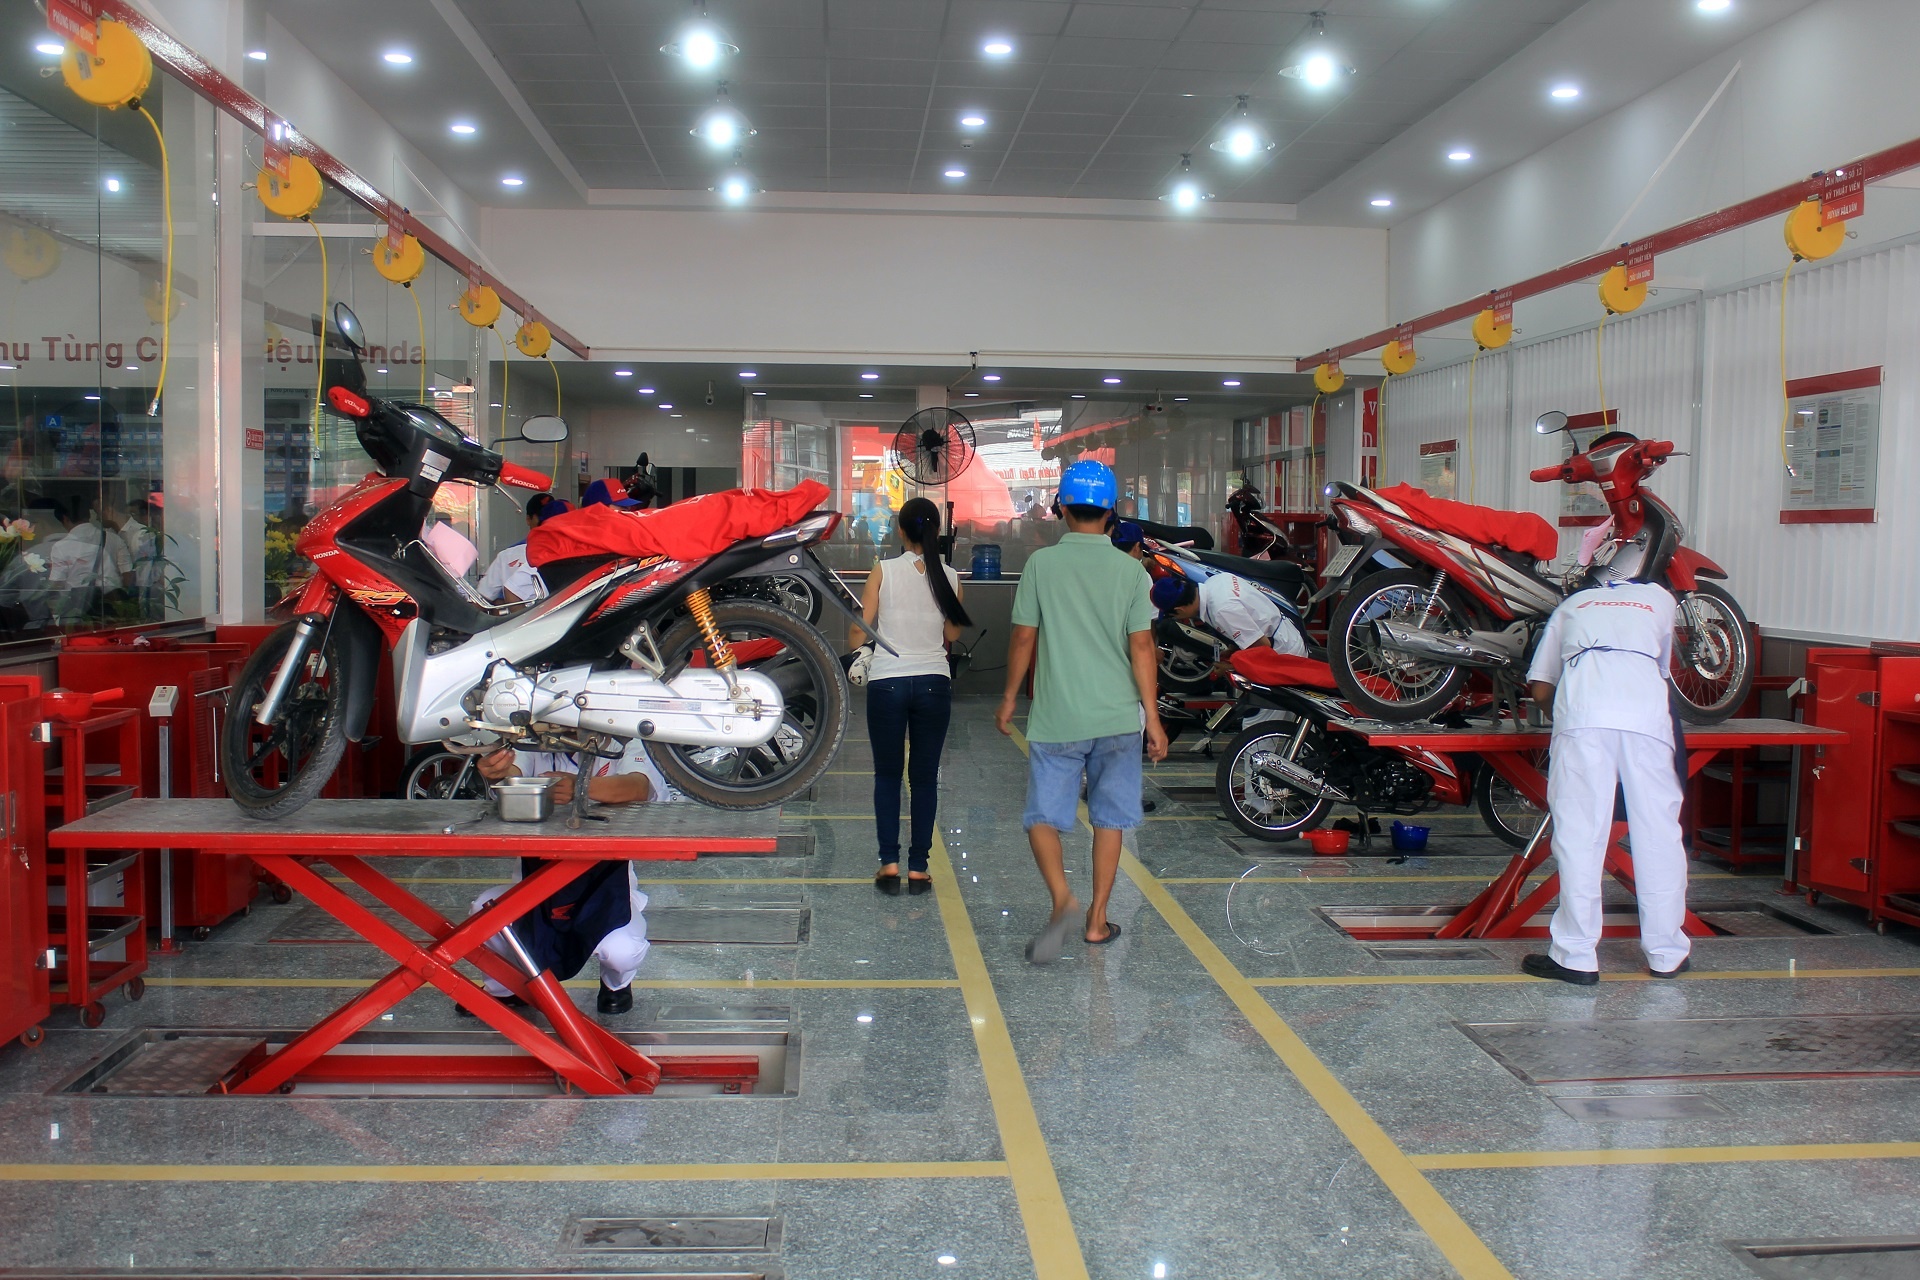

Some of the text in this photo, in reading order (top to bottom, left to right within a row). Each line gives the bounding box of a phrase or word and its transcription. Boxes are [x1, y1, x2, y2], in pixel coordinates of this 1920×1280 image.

[42, 334, 123, 368] Tùng
[49, 417, 57, 426] A
[512, 478, 540, 490] HONDA
[313, 549, 340, 560] HONDA
[1593, 601, 1655, 613] HONDA
